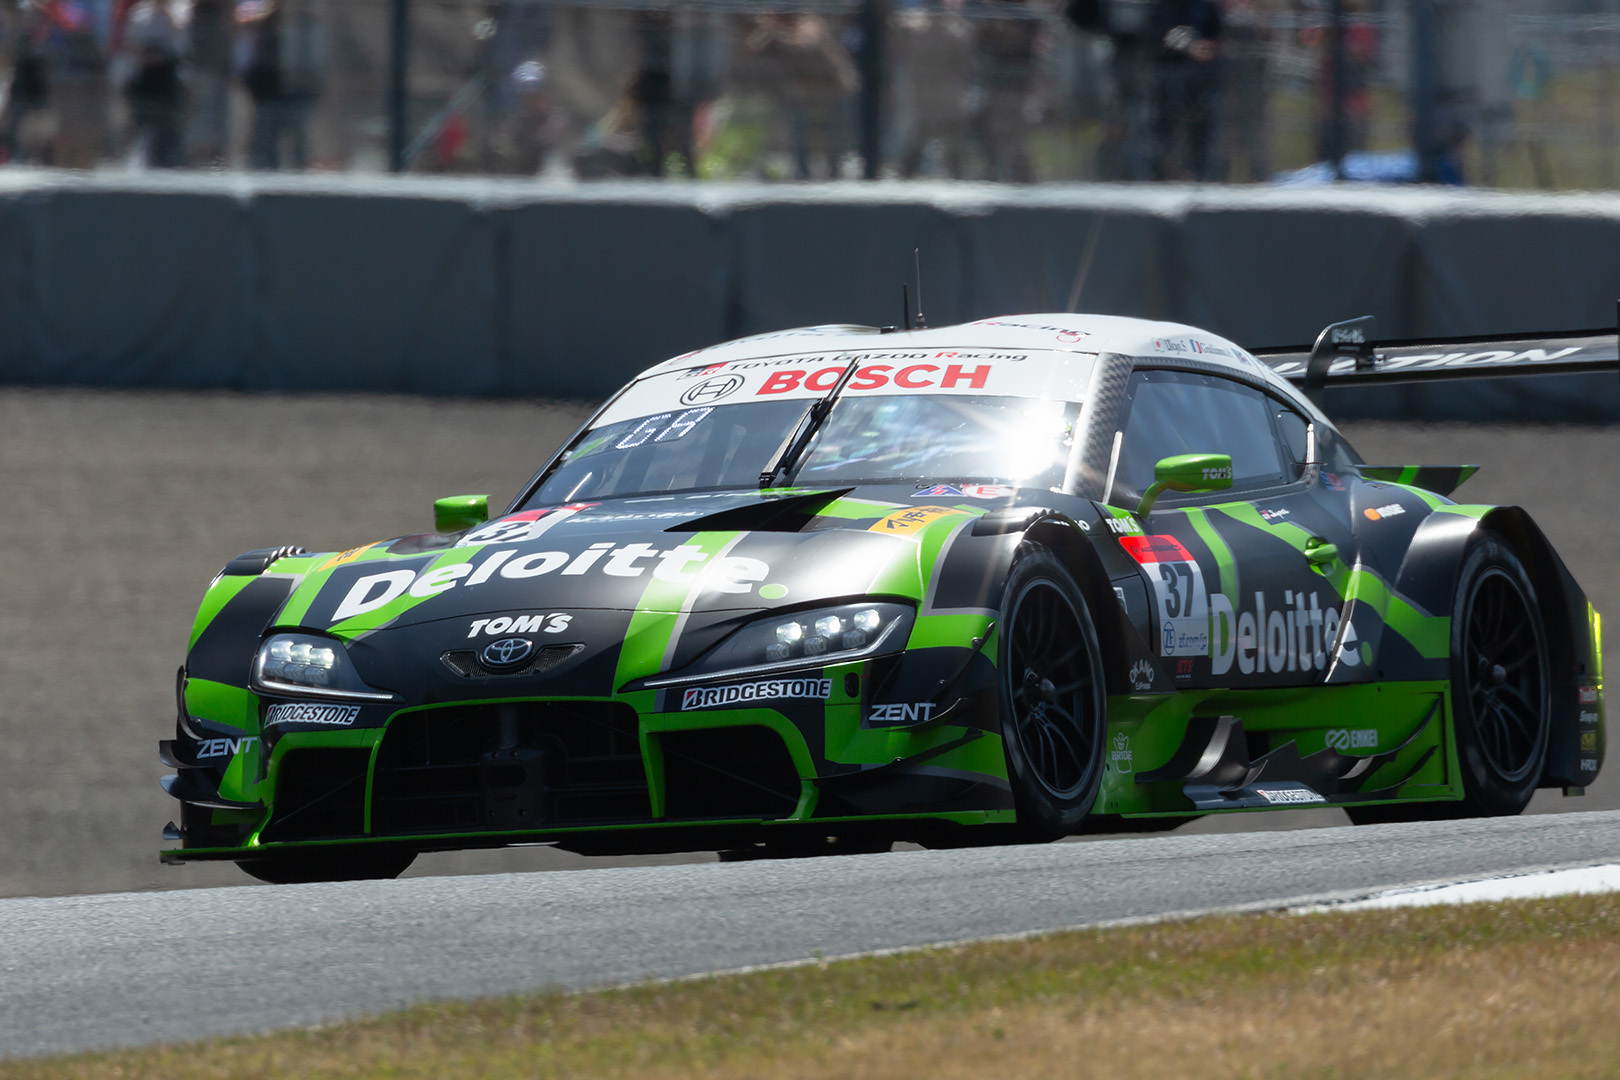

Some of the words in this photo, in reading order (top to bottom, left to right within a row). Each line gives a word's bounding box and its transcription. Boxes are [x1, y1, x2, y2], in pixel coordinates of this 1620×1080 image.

[971, 321, 1091, 337] Racing
[729, 356, 824, 371] TOYOTA
[832, 352, 928, 362] GAZOO
[934, 351, 1028, 362] Racing
[755, 364, 992, 396] BOSCH
[1105, 516, 1140, 533] TOM'S
[1159, 563, 1194, 619] 37
[467, 613, 573, 639] TOM'S
[681, 679, 832, 710] BRIDGESTONE
[264, 703, 361, 728] BRIDGESTONE
[869, 702, 937, 721] ZENT
[197, 737, 258, 759] ZENT
[1111, 750, 1133, 760] BRIDE
